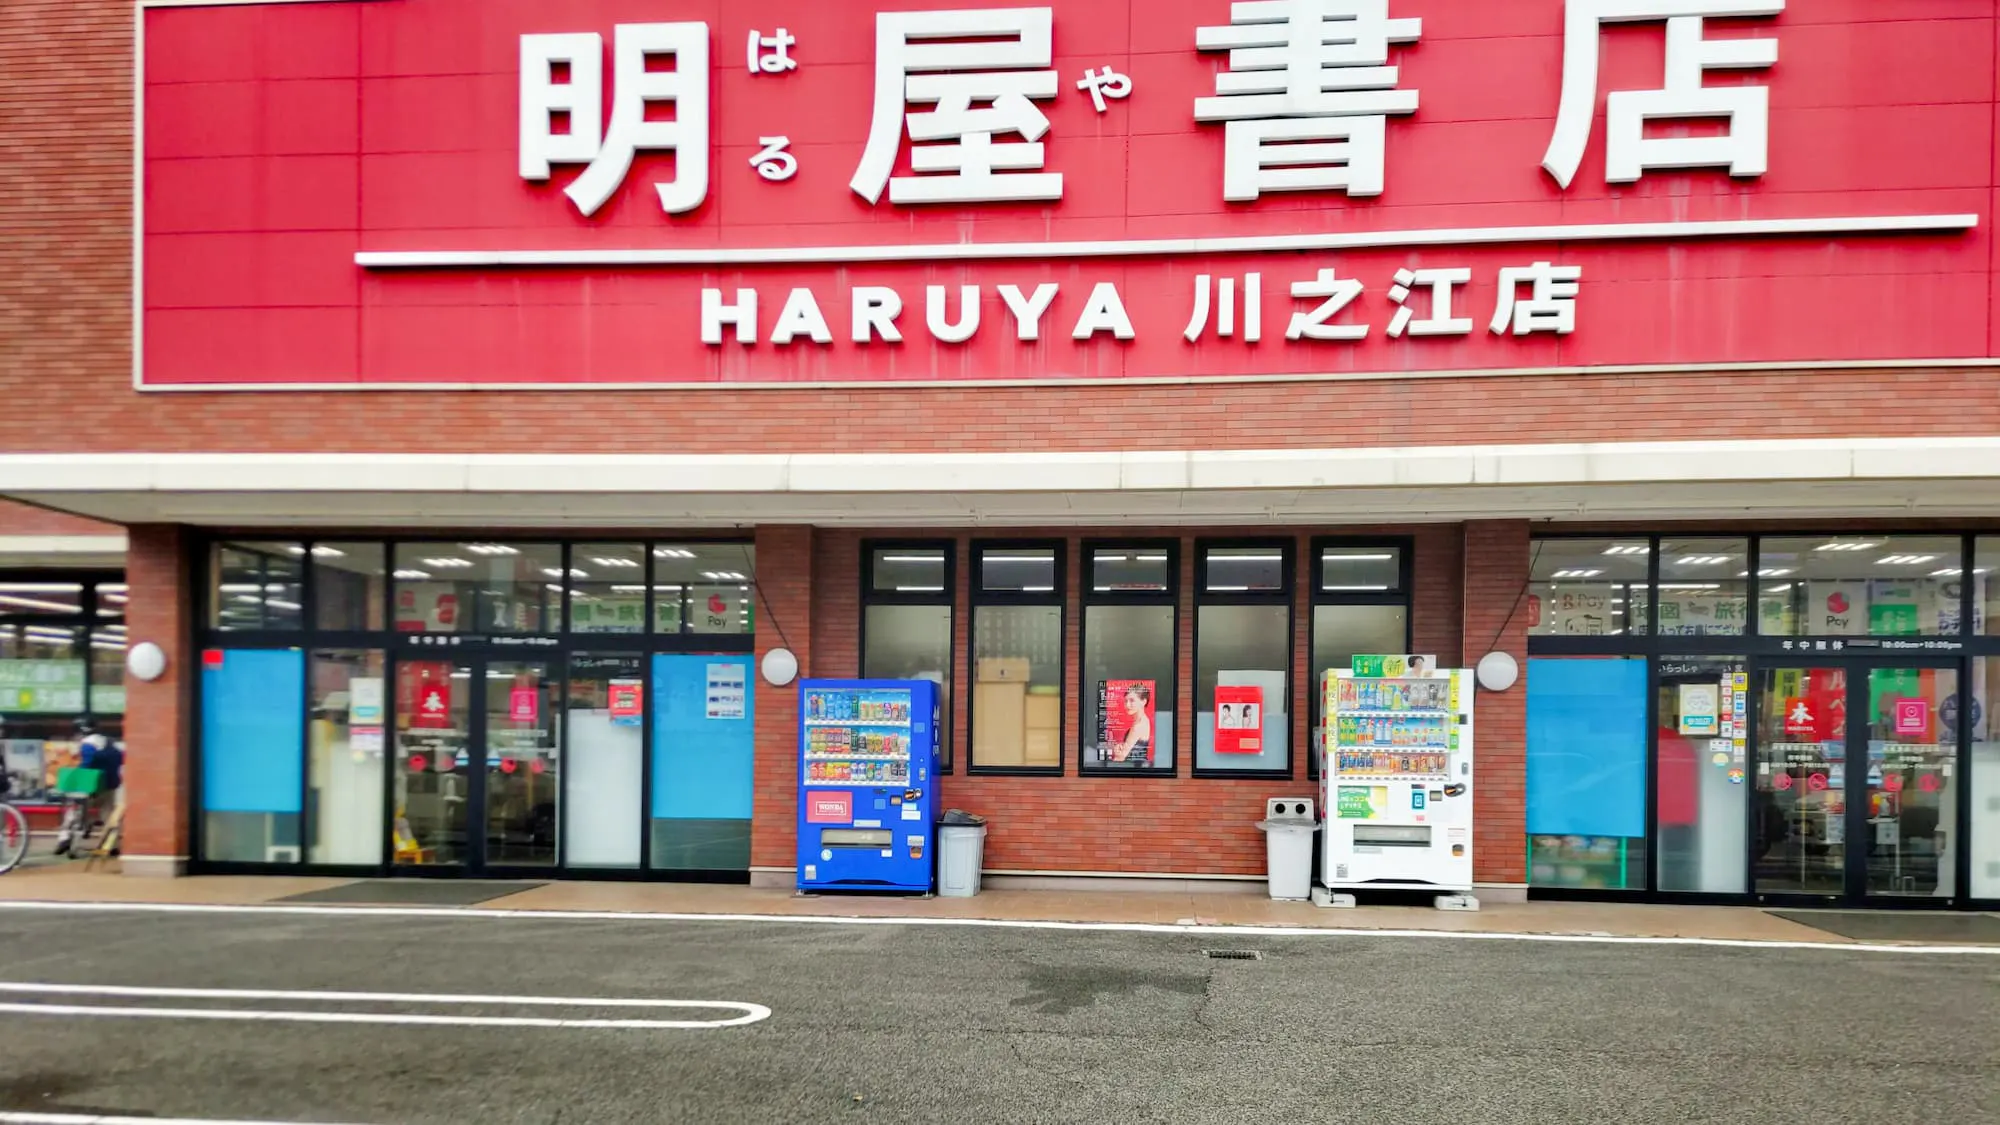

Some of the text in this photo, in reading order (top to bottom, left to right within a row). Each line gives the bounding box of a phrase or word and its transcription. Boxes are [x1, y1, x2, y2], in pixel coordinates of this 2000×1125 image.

[1077, 65, 1132, 112] や
[700, 261, 1582, 345] HARUYA 川之江店
[1826, 615, 1849, 628] Pay
[1789, 701, 1815, 724] 本
